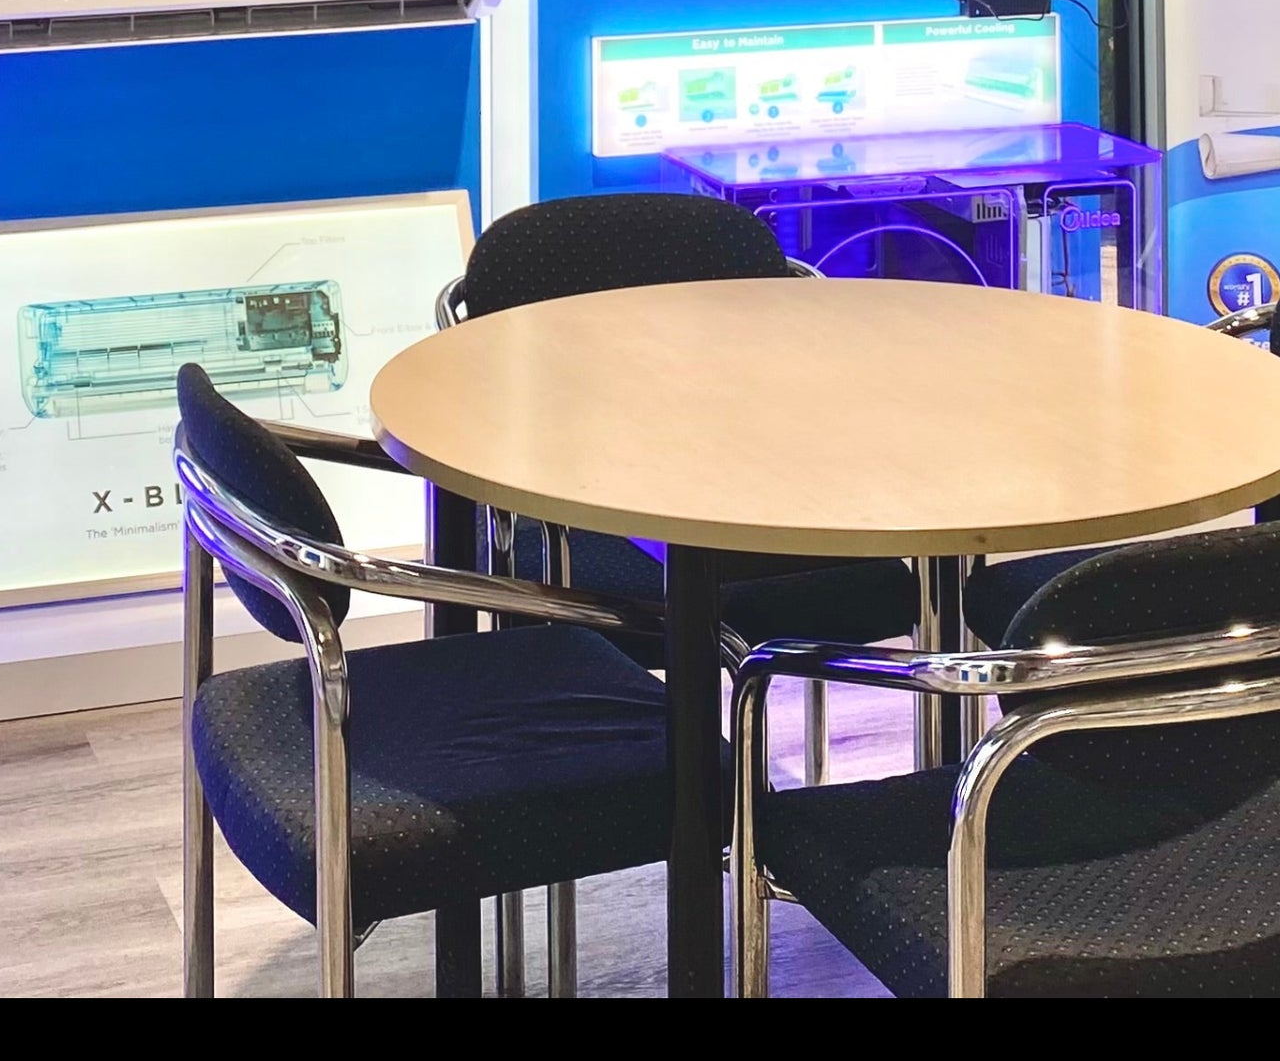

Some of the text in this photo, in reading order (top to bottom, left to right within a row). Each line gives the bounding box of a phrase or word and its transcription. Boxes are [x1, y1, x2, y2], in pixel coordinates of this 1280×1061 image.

[925, 22, 1016, 37] Powerful Cooling
[691, 34, 785, 52] Easy to Maintain
[86, 529, 109, 540] The
